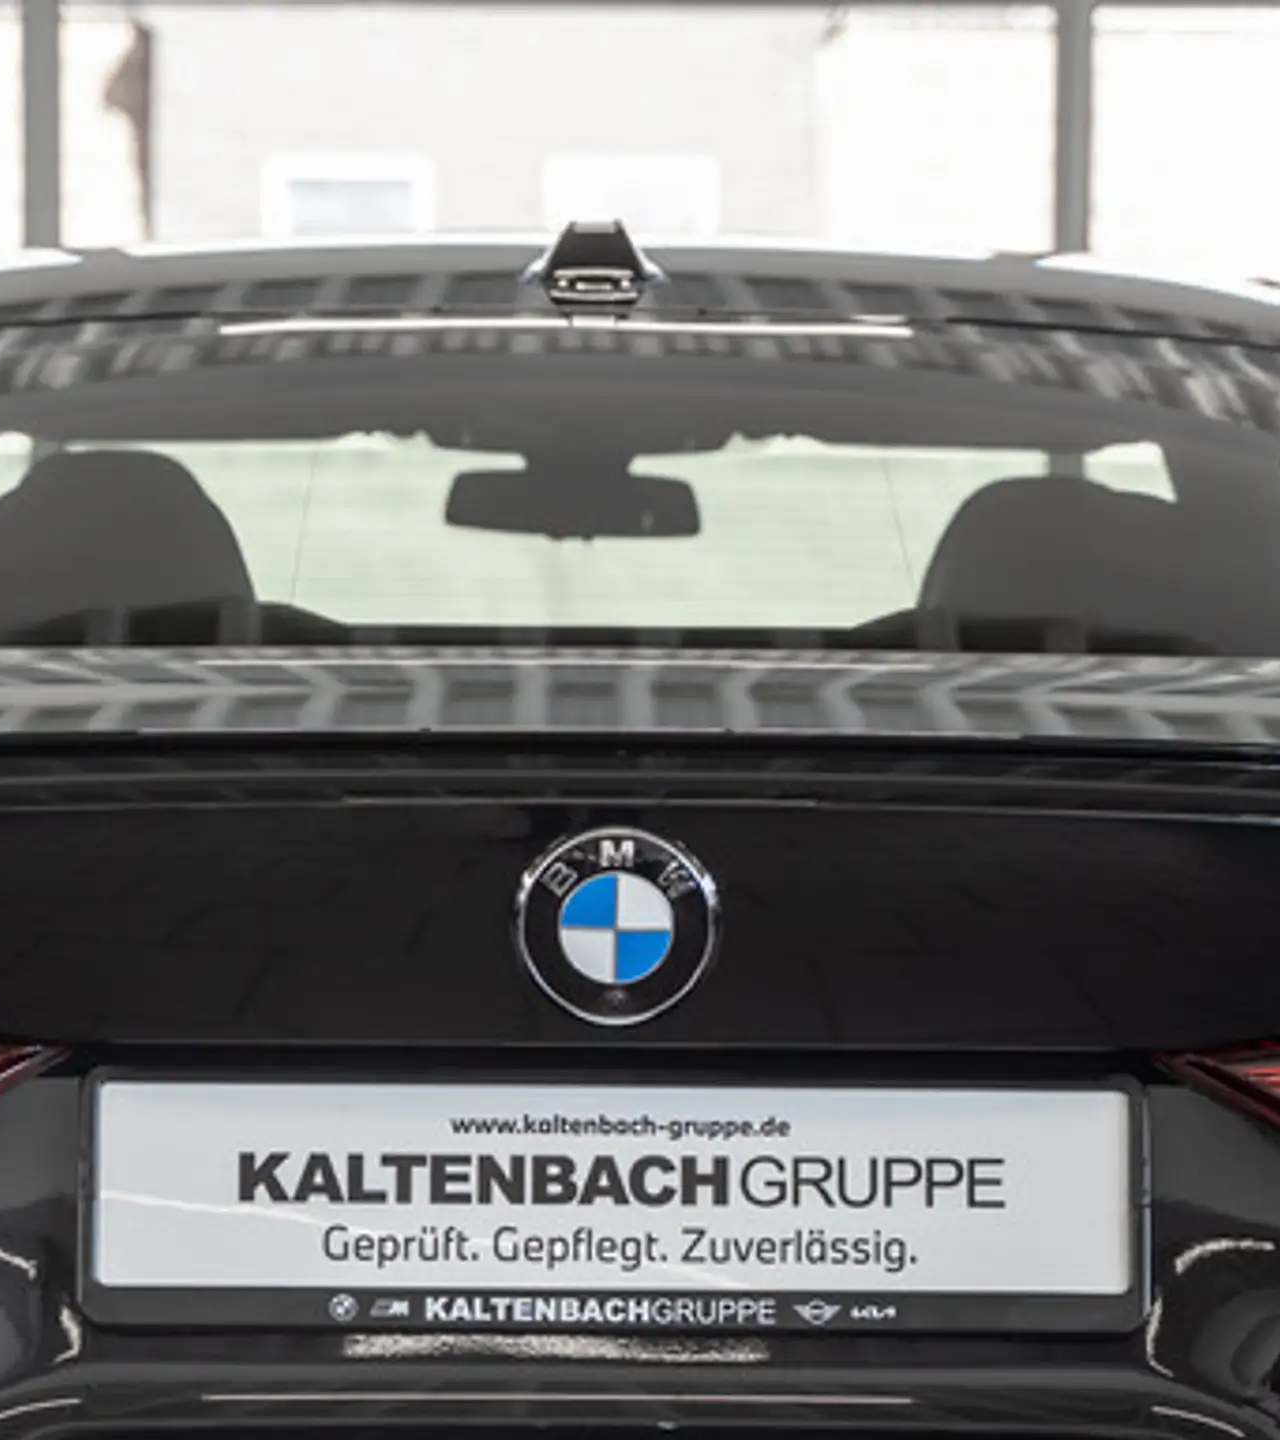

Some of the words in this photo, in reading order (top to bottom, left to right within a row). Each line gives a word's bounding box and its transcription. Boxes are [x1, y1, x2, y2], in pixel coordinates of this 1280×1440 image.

[540, 839, 697, 898] BMW
[451, 1113, 791, 1141] www.kaltenbach-gruppe.de
[238, 1151, 1006, 1208] KALTENBACHGRUPPE
[323, 1225, 479, 1269] Geprüft.
[493, 1225, 668, 1272] Gepflegt.
[680, 1227, 917, 1274] Zuverlässig.
[424, 1297, 777, 1325] KALTENBACHGRUPPE
